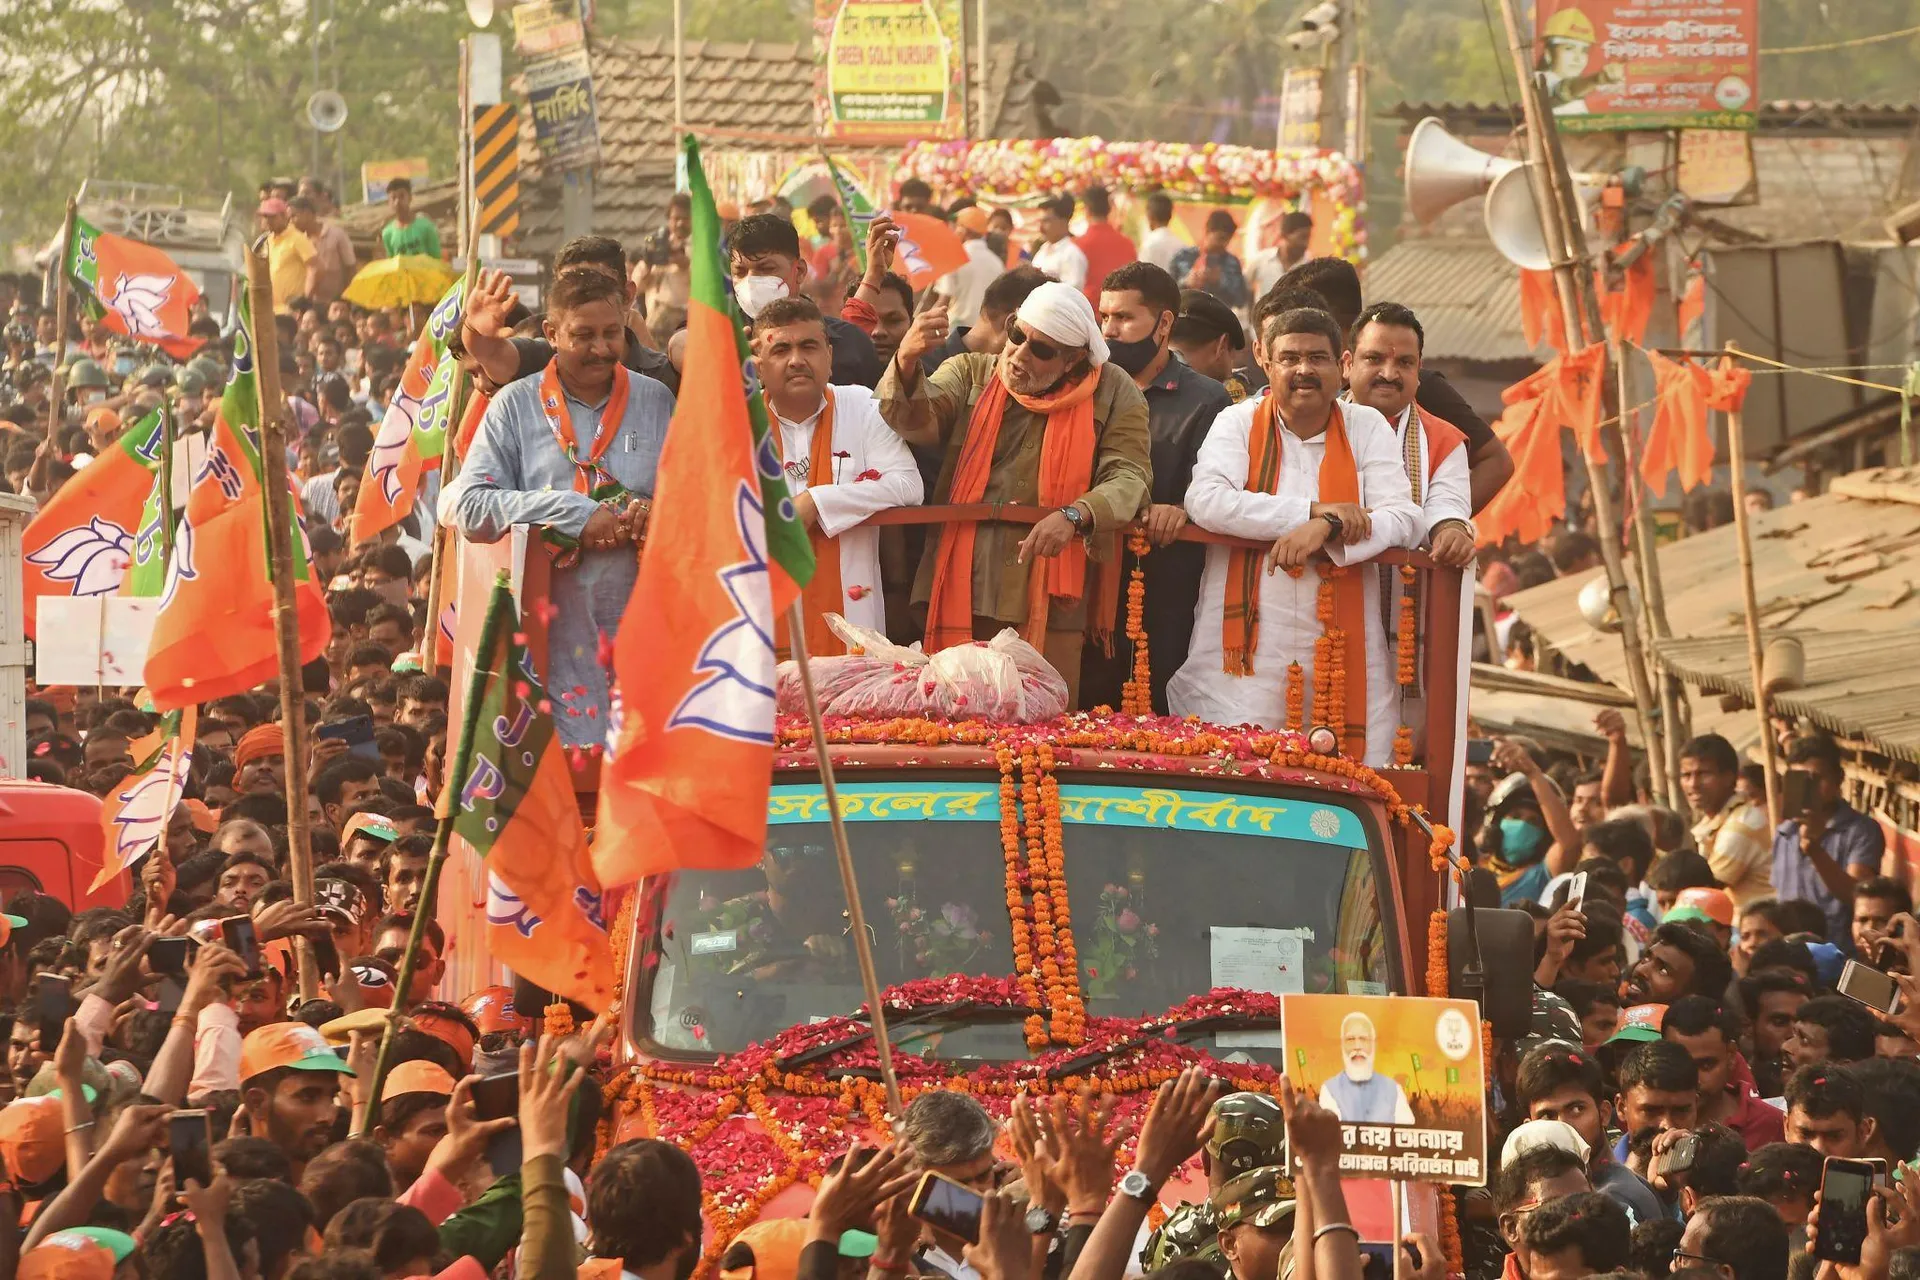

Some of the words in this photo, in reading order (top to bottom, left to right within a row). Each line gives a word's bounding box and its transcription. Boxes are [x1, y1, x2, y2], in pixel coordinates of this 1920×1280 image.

[769, 791, 992, 818] সকলের
[1340, 1125, 1357, 1150] র
[1359, 1127, 1391, 1151] নয়
[1394, 1129, 1464, 1155] অন্যায়
[1339, 1154, 1388, 1172] আসল
[1390, 1152, 1454, 1176] পরিবর্তন
[1455, 1157, 1479, 1177] চাই
